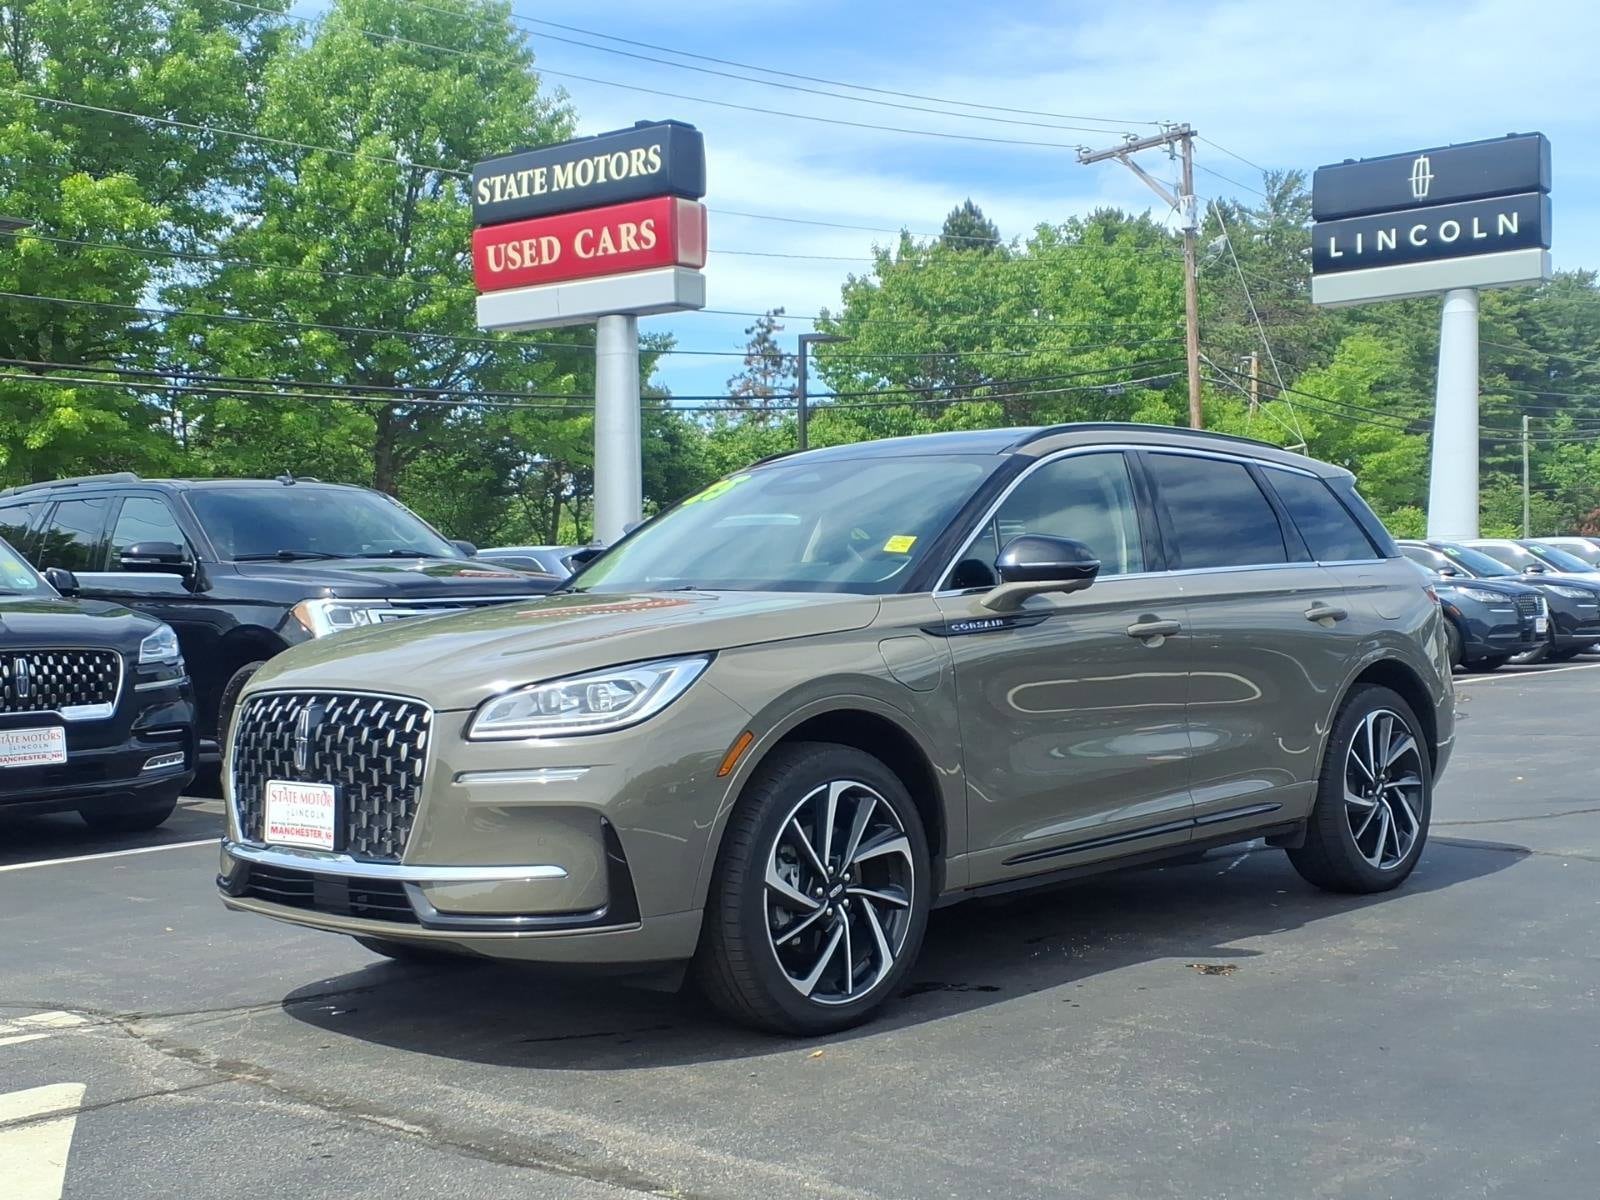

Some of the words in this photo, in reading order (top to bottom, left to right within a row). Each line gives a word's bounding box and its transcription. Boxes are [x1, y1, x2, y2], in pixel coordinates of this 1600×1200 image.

[477, 167, 548, 206] STATE
[553, 144, 661, 191] MOTORS
[486, 235, 561, 273] USED
[574, 218, 657, 259] CARS
[1329, 211, 1519, 258] LINCOLN
[951, 619, 1004, 631] CORSAIR
[0, 734, 20, 744] TATE
[22, 732, 61, 742] MOTORS
[271, 789, 298, 804] STATE
[300, 791, 333, 807] MOTOR
